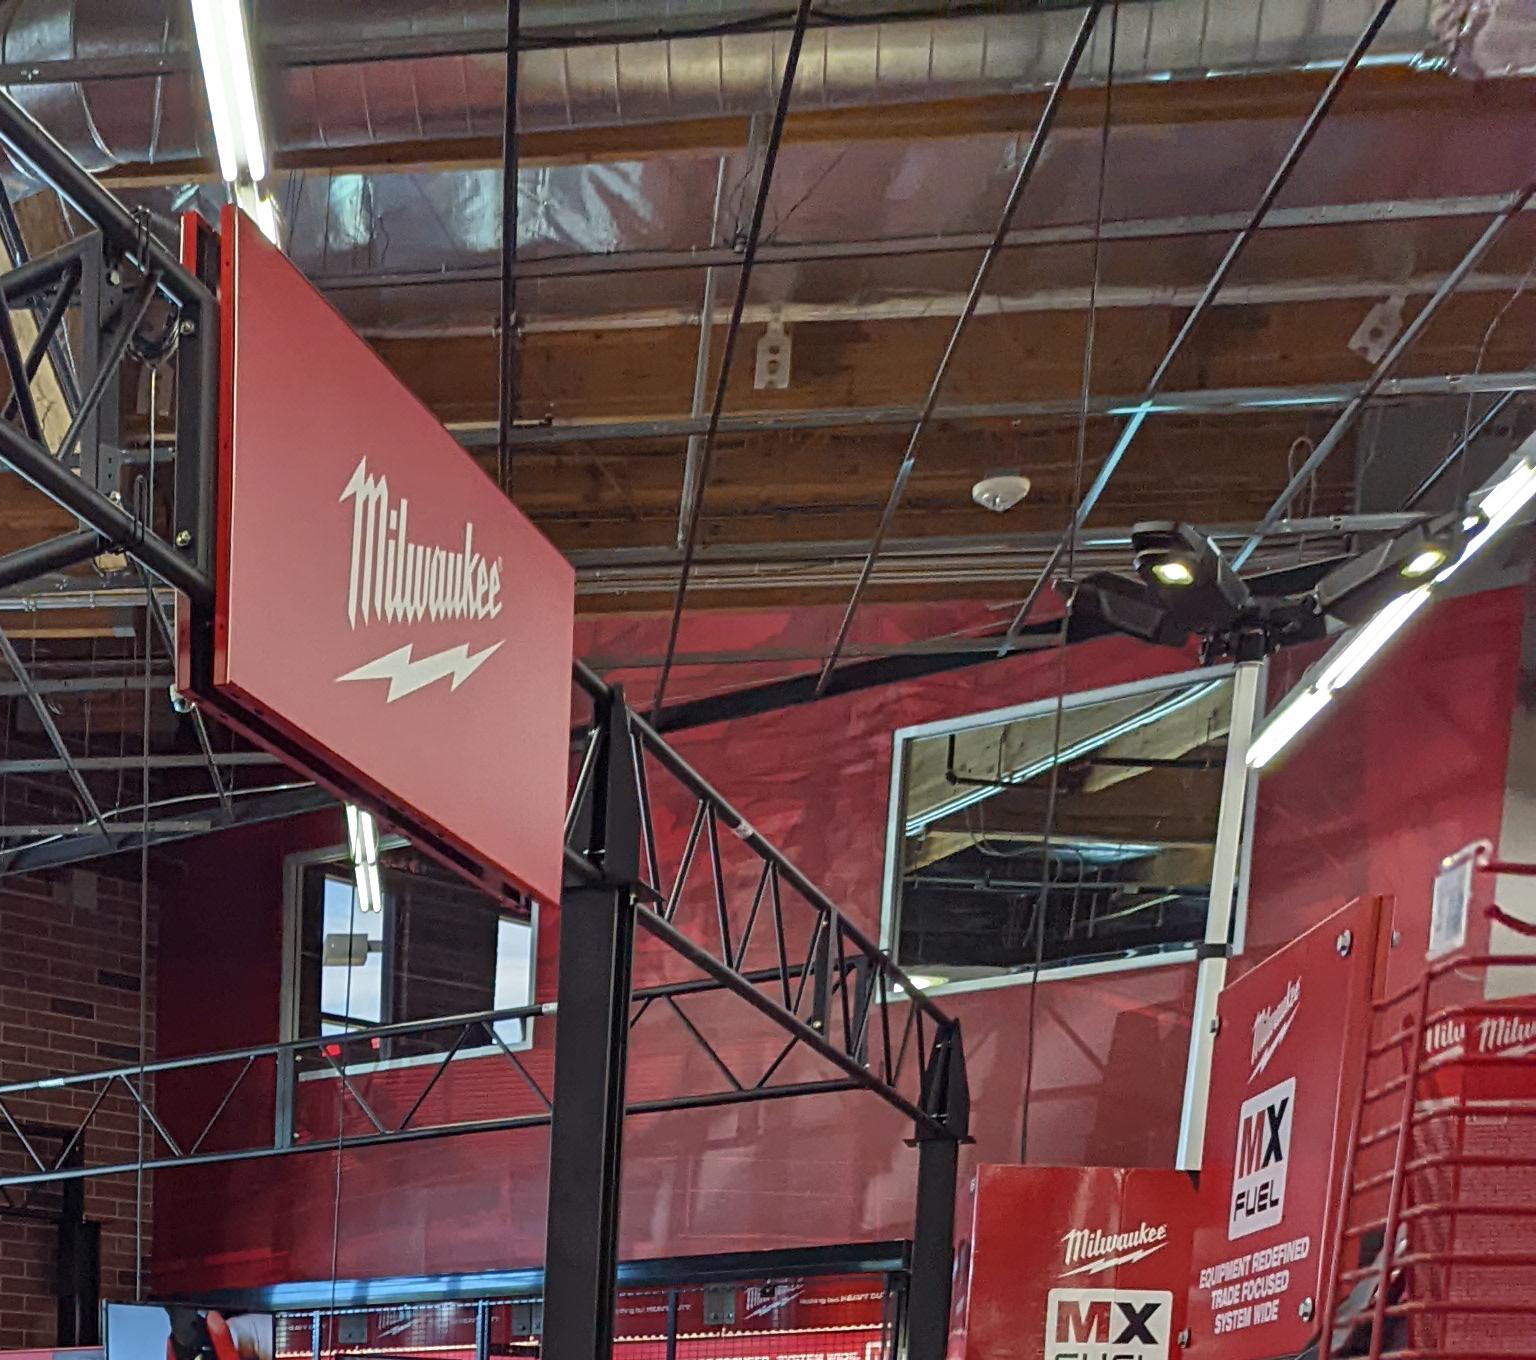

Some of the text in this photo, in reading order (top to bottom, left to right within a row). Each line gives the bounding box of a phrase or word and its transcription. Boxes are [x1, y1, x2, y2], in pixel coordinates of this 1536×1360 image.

[339, 455, 503, 631] Milwaukee
[1238, 1096, 1289, 1180] MX
[1233, 1181, 1280, 1222] FUEL
[1059, 1221, 1167, 1267] Milwaukee
[1199, 1236, 1310, 1289] EQUIPMENT REDEFINED
[1211, 1269, 1289, 1310] TRADE FOCUSED
[1056, 1301, 1161, 1345] MX
[1214, 1299, 1279, 1335] SYSTEM WIDE
